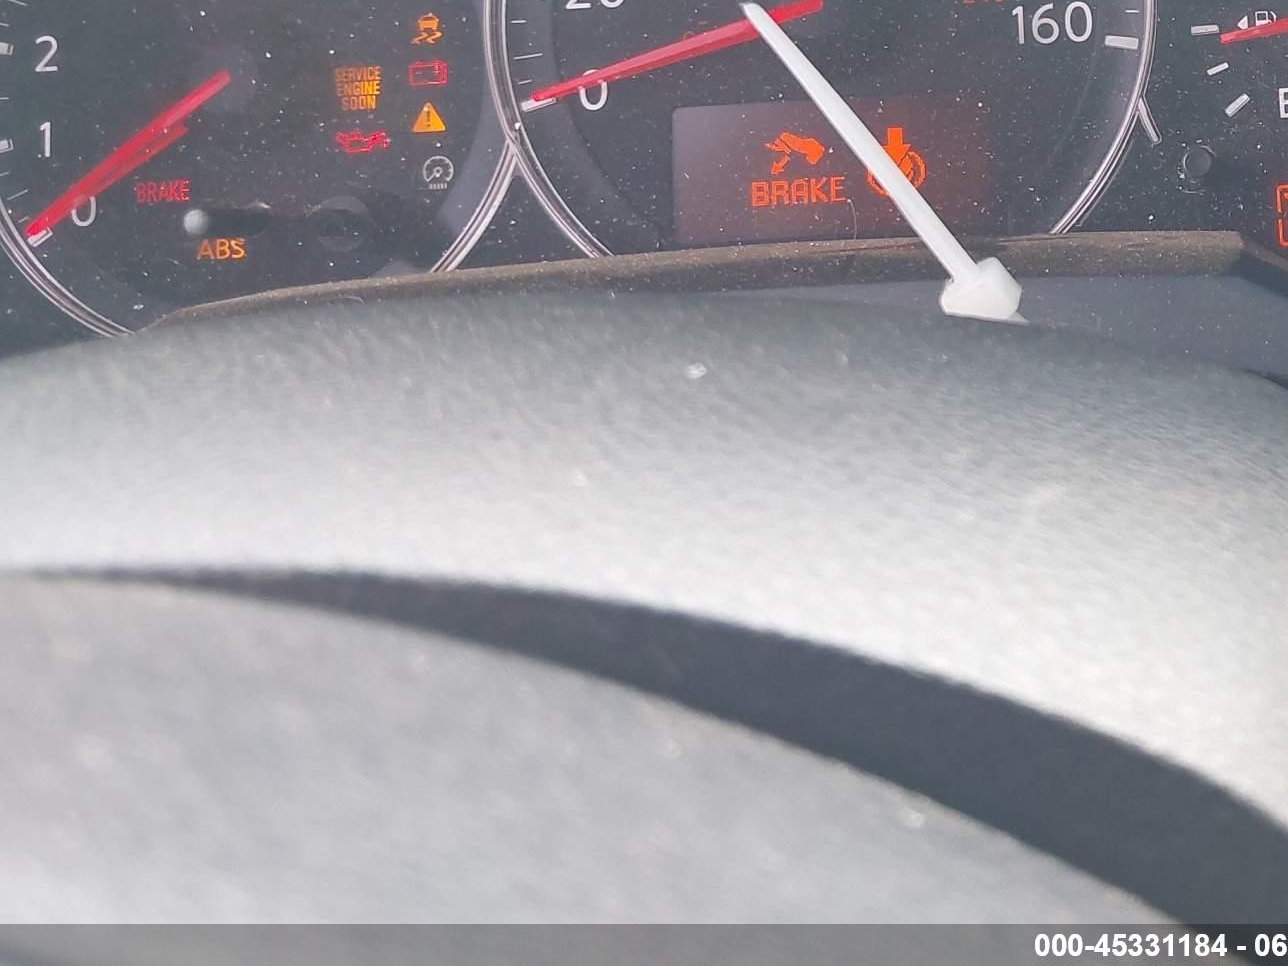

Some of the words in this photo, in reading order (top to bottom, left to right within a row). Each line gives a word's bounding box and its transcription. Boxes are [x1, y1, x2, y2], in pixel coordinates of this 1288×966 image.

[1011, 2, 1093, 44] 160
[35, 36, 58, 72] 2
[335, 66, 381, 81] SERVICE
[336, 80, 381, 97] ENGINE
[579, 69, 608, 111] 0
[341, 96, 377, 110] SOON
[39, 122, 51, 156] 1
[135, 179, 190, 202] BRAKE
[751, 177, 846, 206] BRAKE
[196, 238, 246, 260] ABS
